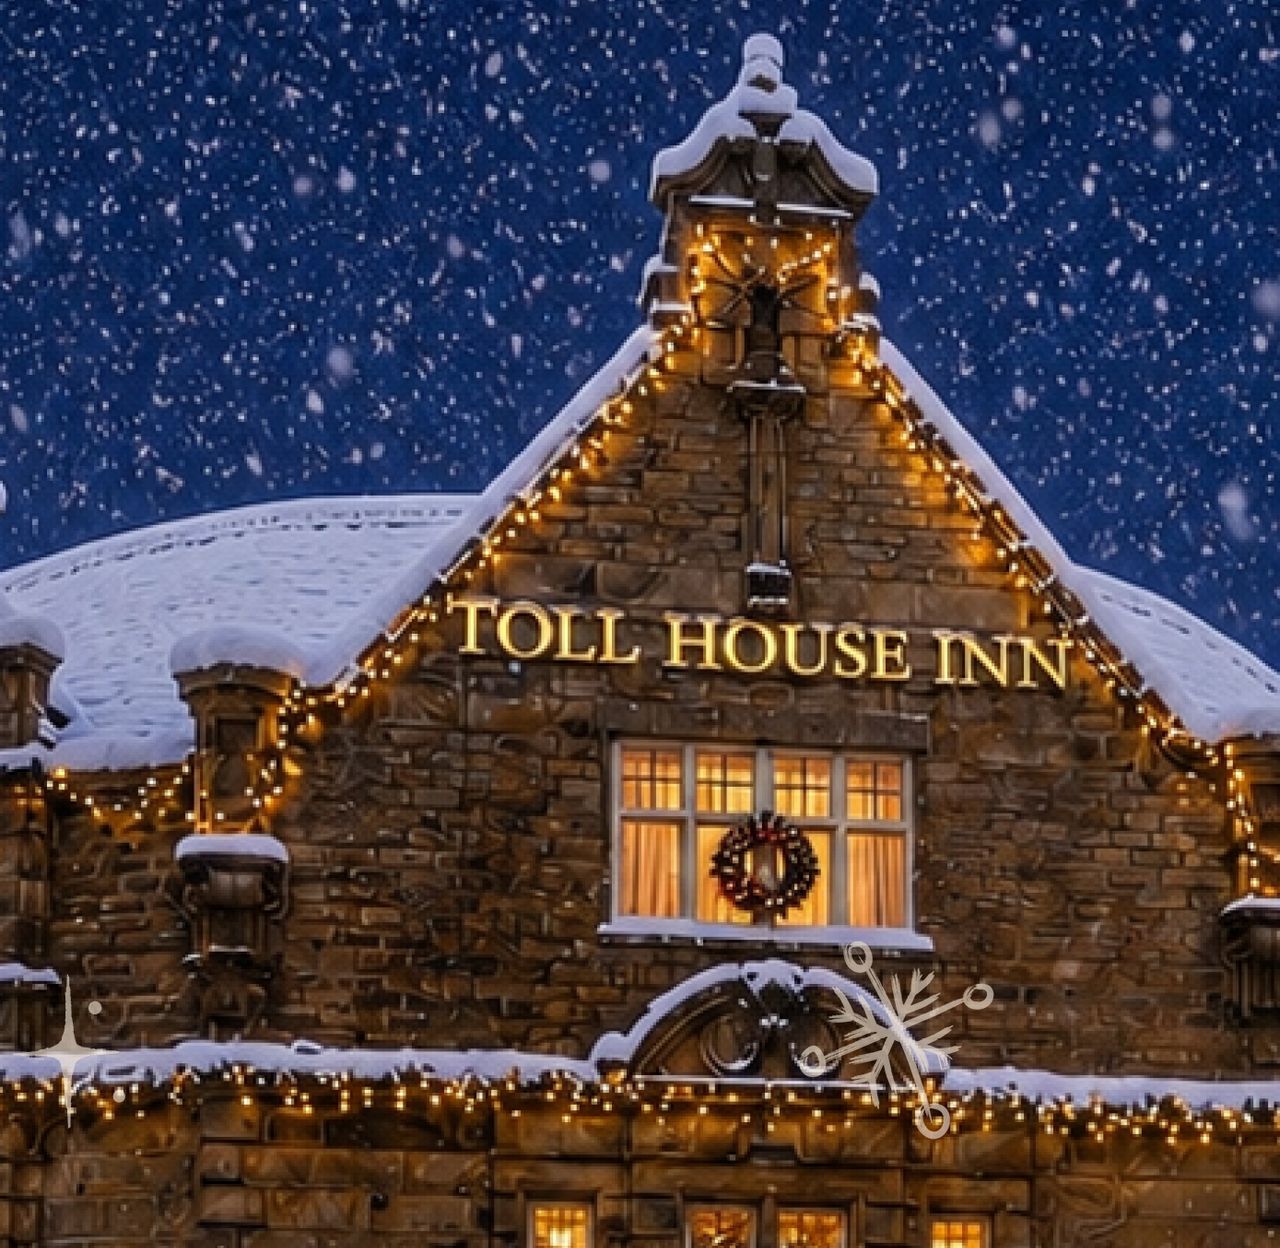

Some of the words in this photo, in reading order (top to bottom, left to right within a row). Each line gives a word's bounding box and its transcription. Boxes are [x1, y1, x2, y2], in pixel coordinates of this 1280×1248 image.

[453, 600, 640, 664] TOLL
[663, 611, 910, 679] HOUSE
[931, 629, 1072, 689] INN
